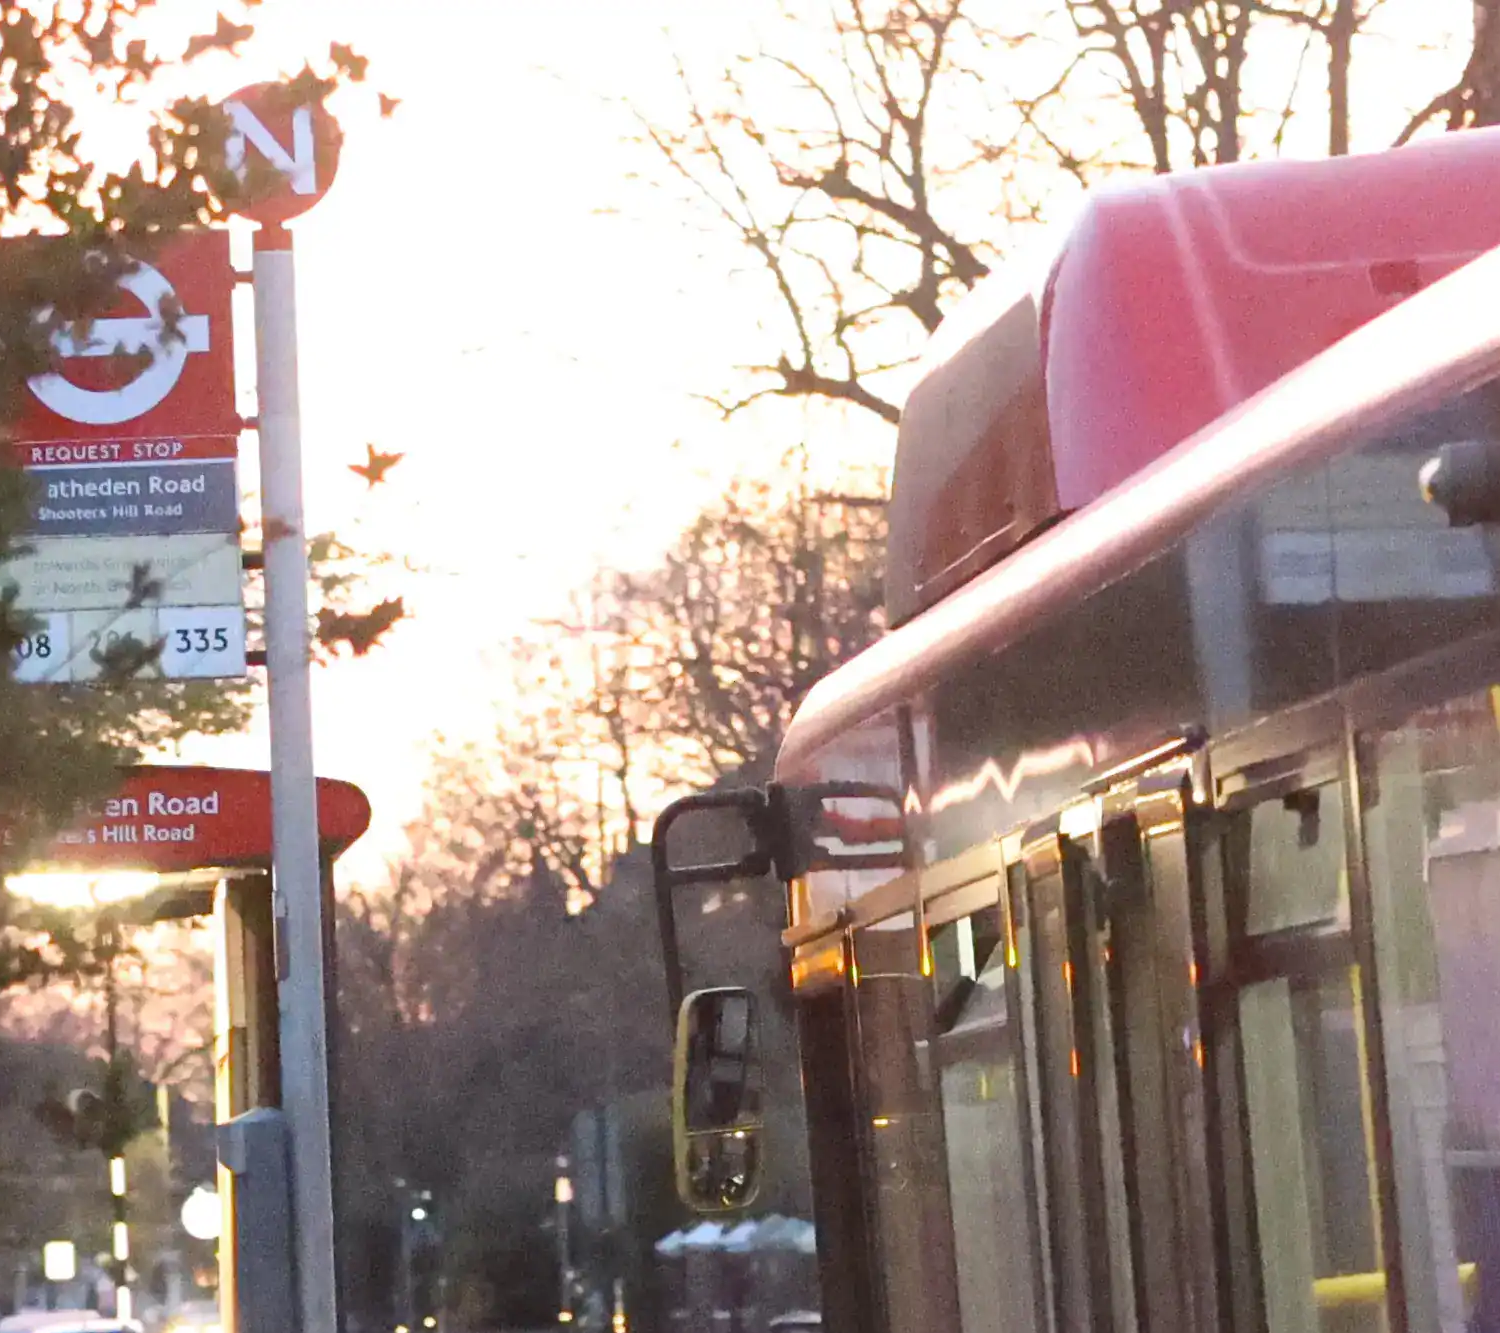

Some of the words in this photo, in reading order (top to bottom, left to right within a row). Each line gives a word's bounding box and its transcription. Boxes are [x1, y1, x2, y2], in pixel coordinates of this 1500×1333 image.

[223, 99, 316, 194] N
[31, 444, 120, 462] REQUEST
[133, 441, 183, 459] STOP
[47, 478, 140, 499] atheden
[149, 473, 206, 495] Road
[38, 504, 107, 521] Shooters
[112, 503, 138, 518] Hill
[144, 501, 183, 517] Road
[16, 635, 51, 660] 08
[175, 627, 228, 653] 335
[147, 789, 220, 816] Road
[102, 825, 139, 844] Hill
[143, 823, 196, 842] Road
